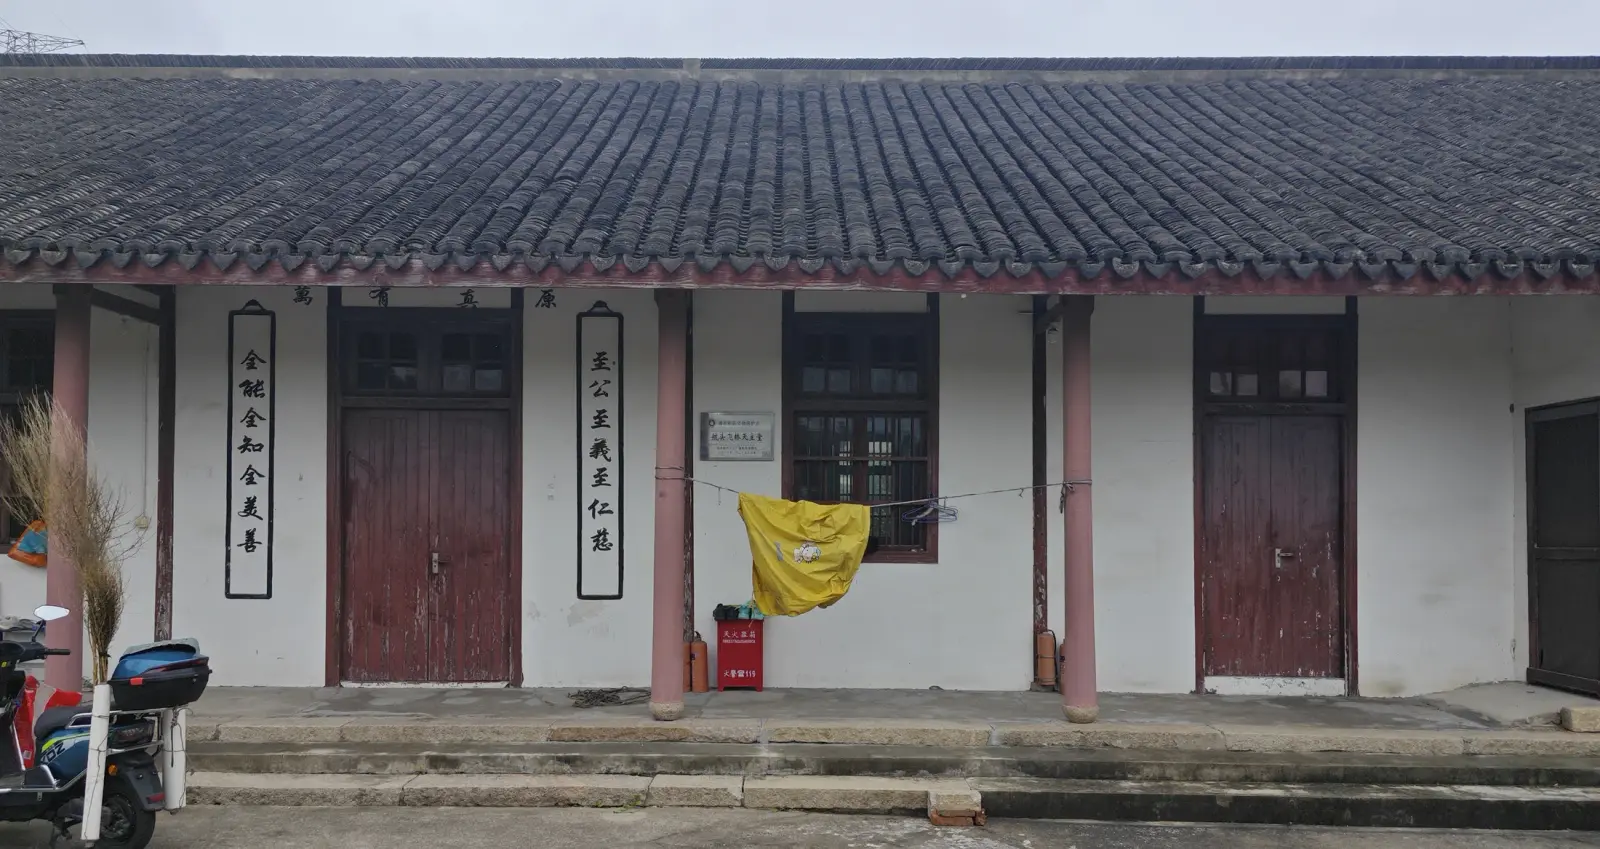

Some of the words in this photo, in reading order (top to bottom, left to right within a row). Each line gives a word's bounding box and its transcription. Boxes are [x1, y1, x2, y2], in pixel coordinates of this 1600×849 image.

[237, 349, 267, 553] 全能全知全美善
[587, 351, 614, 552] 至公至義至仁慈
